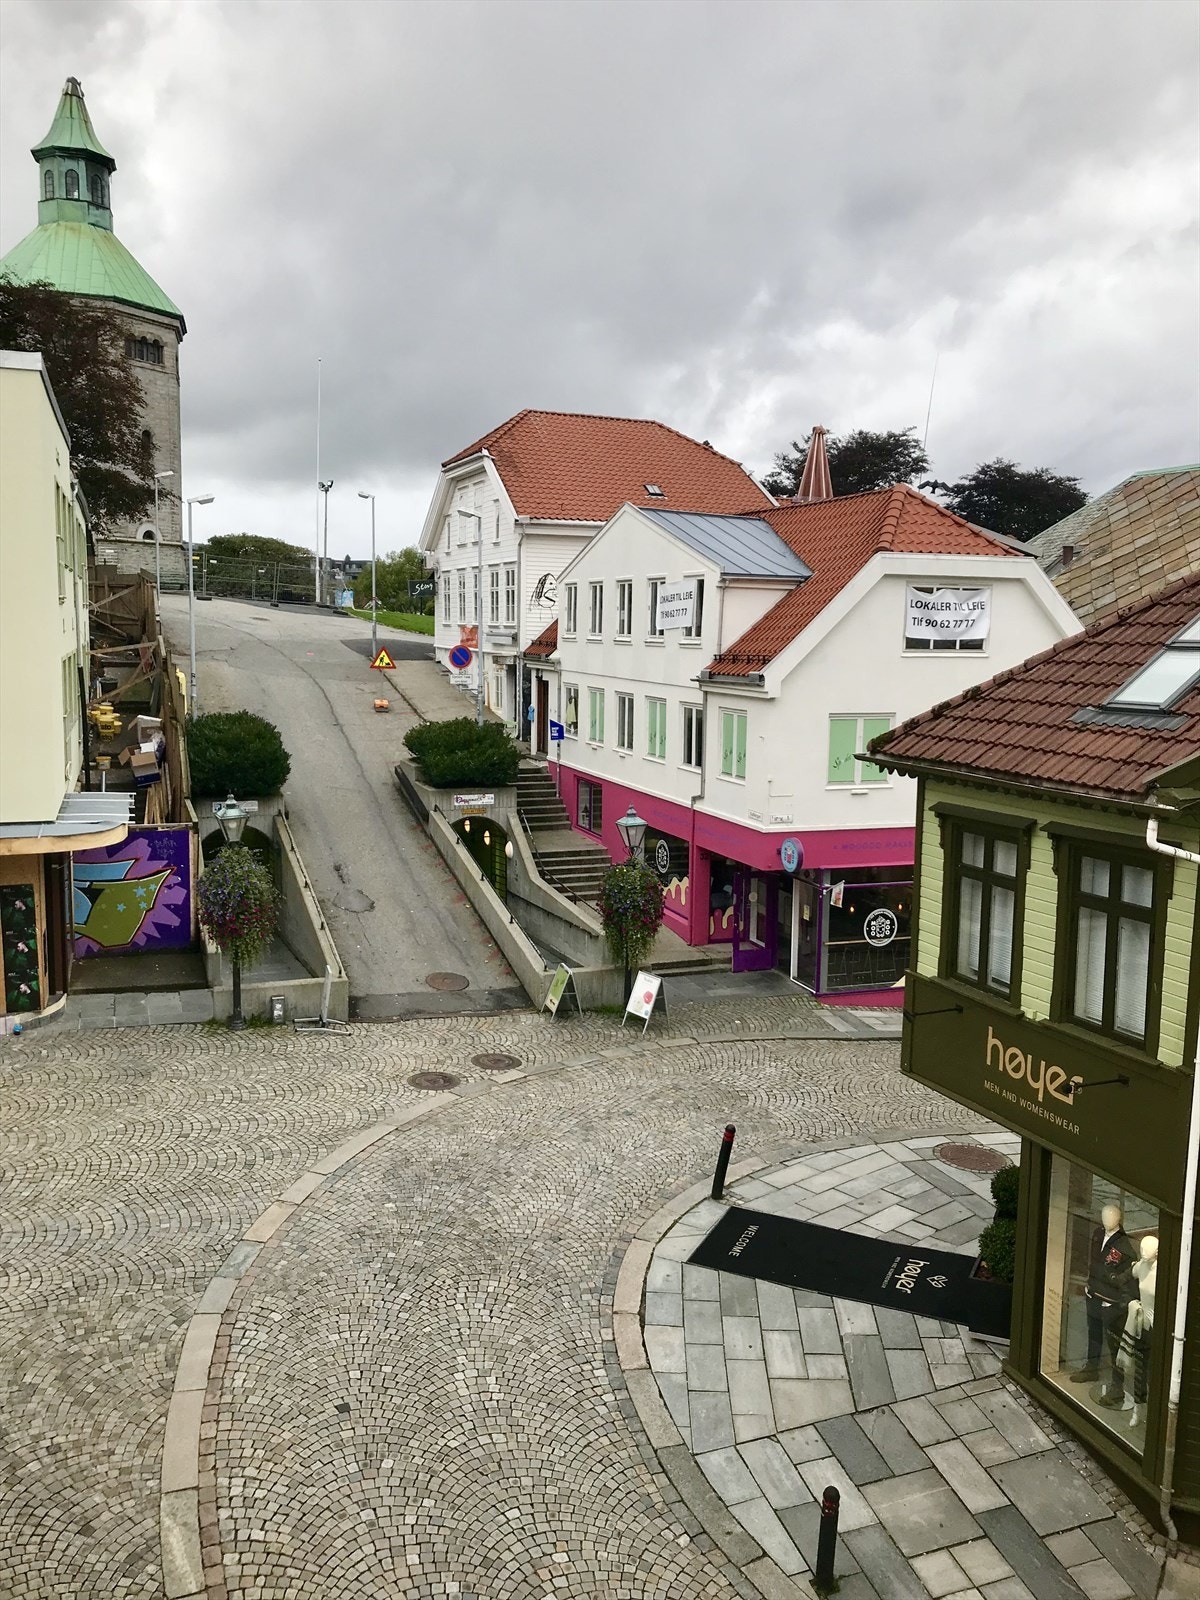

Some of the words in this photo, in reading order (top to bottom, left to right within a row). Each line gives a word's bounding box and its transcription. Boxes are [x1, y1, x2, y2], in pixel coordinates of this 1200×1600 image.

[683, 591, 693, 600] LEIE
[910, 599, 951, 611] LOKALER
[953, 602, 966, 611] TIL
[966, 601, 985, 611] LEIE
[681, 608, 687, 616] 77
[912, 616, 924, 626] Tlf
[925, 618, 938, 628] 90
[940, 620, 950, 628] 62
[952, 620, 964, 628] 77
[964, 618, 976, 628] 77
[984, 1080, 1000, 1094] MEN
[1002, 1089, 1017, 1103] AND
[1020, 1097, 1080, 1135] WOMENSWEAR
[728, 1225, 760, 1257] WELCOME
[894, 1258, 930, 1294] høyer
